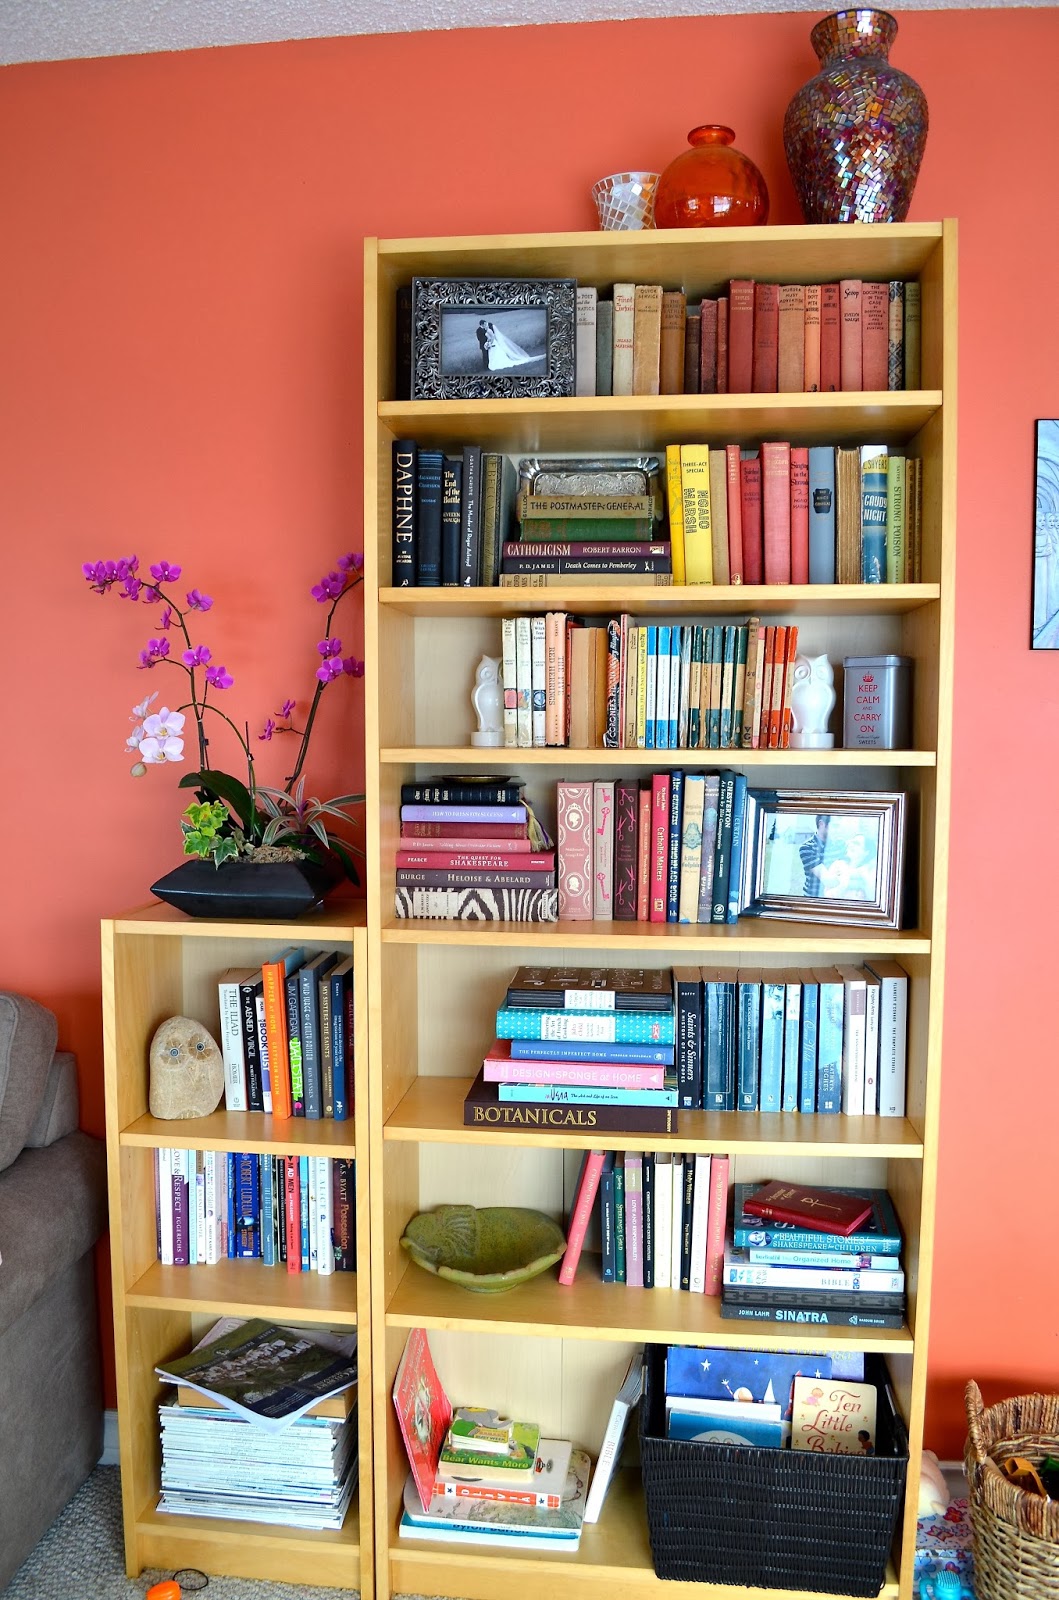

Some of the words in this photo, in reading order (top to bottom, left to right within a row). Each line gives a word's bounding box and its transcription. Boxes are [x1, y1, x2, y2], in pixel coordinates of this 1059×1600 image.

[844, 288, 859, 299] Scoop
[868, 460, 887, 469] SAYERS
[396, 453, 413, 543] DAPHNE
[445, 488, 452, 497] of
[530, 502, 548, 510] THE
[684, 488, 697, 533] MARSH
[698, 490, 710, 529] NGAIO
[863, 509, 886, 522] NIGHT
[507, 544, 571, 557] CATHOLICISM
[893, 525, 901, 557] POISON
[608, 562, 637, 570] Pemberley
[858, 684, 878, 692] KEEP
[856, 696, 880, 704] CALM
[854, 713, 882, 721] CARRY
[672, 777, 681, 790] Alec
[725, 781, 734, 828] CHESTERTON
[657, 827, 665, 854] Catholic
[656, 856, 664, 881] Matters
[670, 840, 679, 882] COMMONPLACE
[447, 873, 477, 882] HELOISE
[494, 875, 531, 884] ABELARD
[288, 983, 296, 996] JIM
[231, 1012, 239, 1036] ILIAD
[245, 1006, 254, 1033] AENEID
[288, 999, 298, 1036] GAFFIGAN
[688, 1012, 696, 1038] Saints
[247, 1036, 256, 1058] VIRGIL
[687, 1049, 696, 1080] Sinners
[473, 1106, 597, 1126] BOTANICALS
[241, 1160, 252, 1186] ROBERT
[685, 1170, 693, 1184] Holy
[174, 1175, 184, 1212] RESPECT
[242, 1188, 252, 1216] LUDLUM
[341, 1204, 350, 1249] Possession
[772, 1240, 828, 1250] SHAKESPEARE
[835, 1244, 877, 1252] CHILDREN
[779, 1233, 826, 1242] BEAUTIFUL
[826, 1235, 865, 1244] STORIES
[821, 1278, 850, 1286] BIBLE
[775, 1310, 828, 1323] SINATRA
[829, 1390, 861, 1413] Ten
[802, 1410, 852, 1435] Little
[443, 1454, 465, 1464] Bear
[468, 1457, 500, 1466] Wants
[502, 1459, 529, 1469] More
[460, 1489, 531, 1503] OLIVIA
